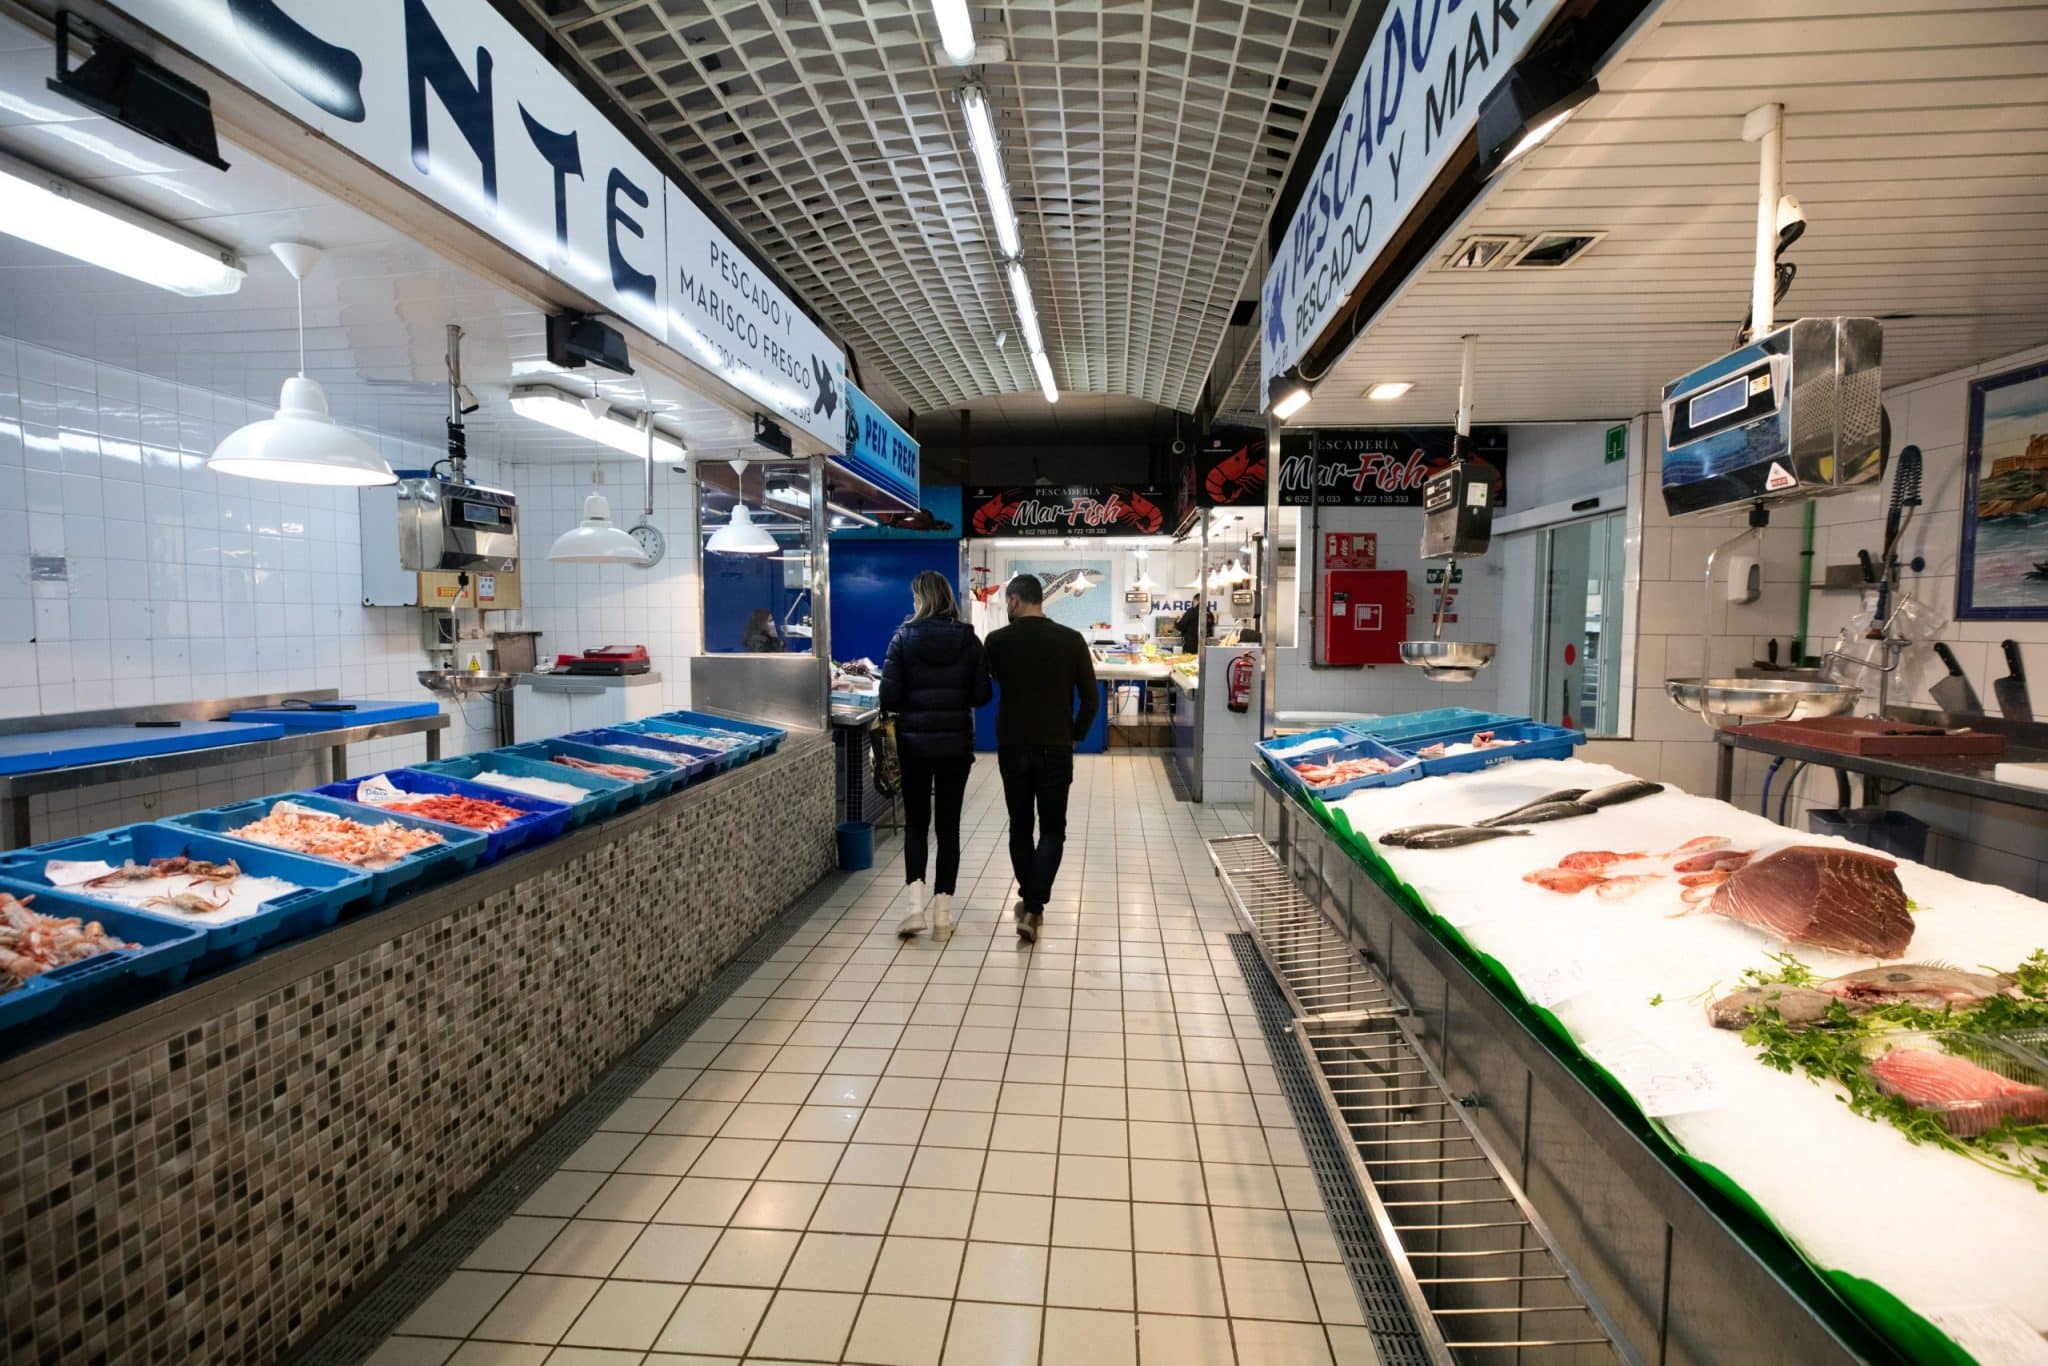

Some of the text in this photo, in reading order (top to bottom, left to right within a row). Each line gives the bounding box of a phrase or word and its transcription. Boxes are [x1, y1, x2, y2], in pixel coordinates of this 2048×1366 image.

[1295, 0, 1534, 347] PESCADO Y MAR
[680, 264, 811, 390] MARISCO FRESCO
[710, 239, 792, 336] PESCADO Y
[865, 413, 888, 460] PEIX
[892, 437, 916, 479] FRESC
